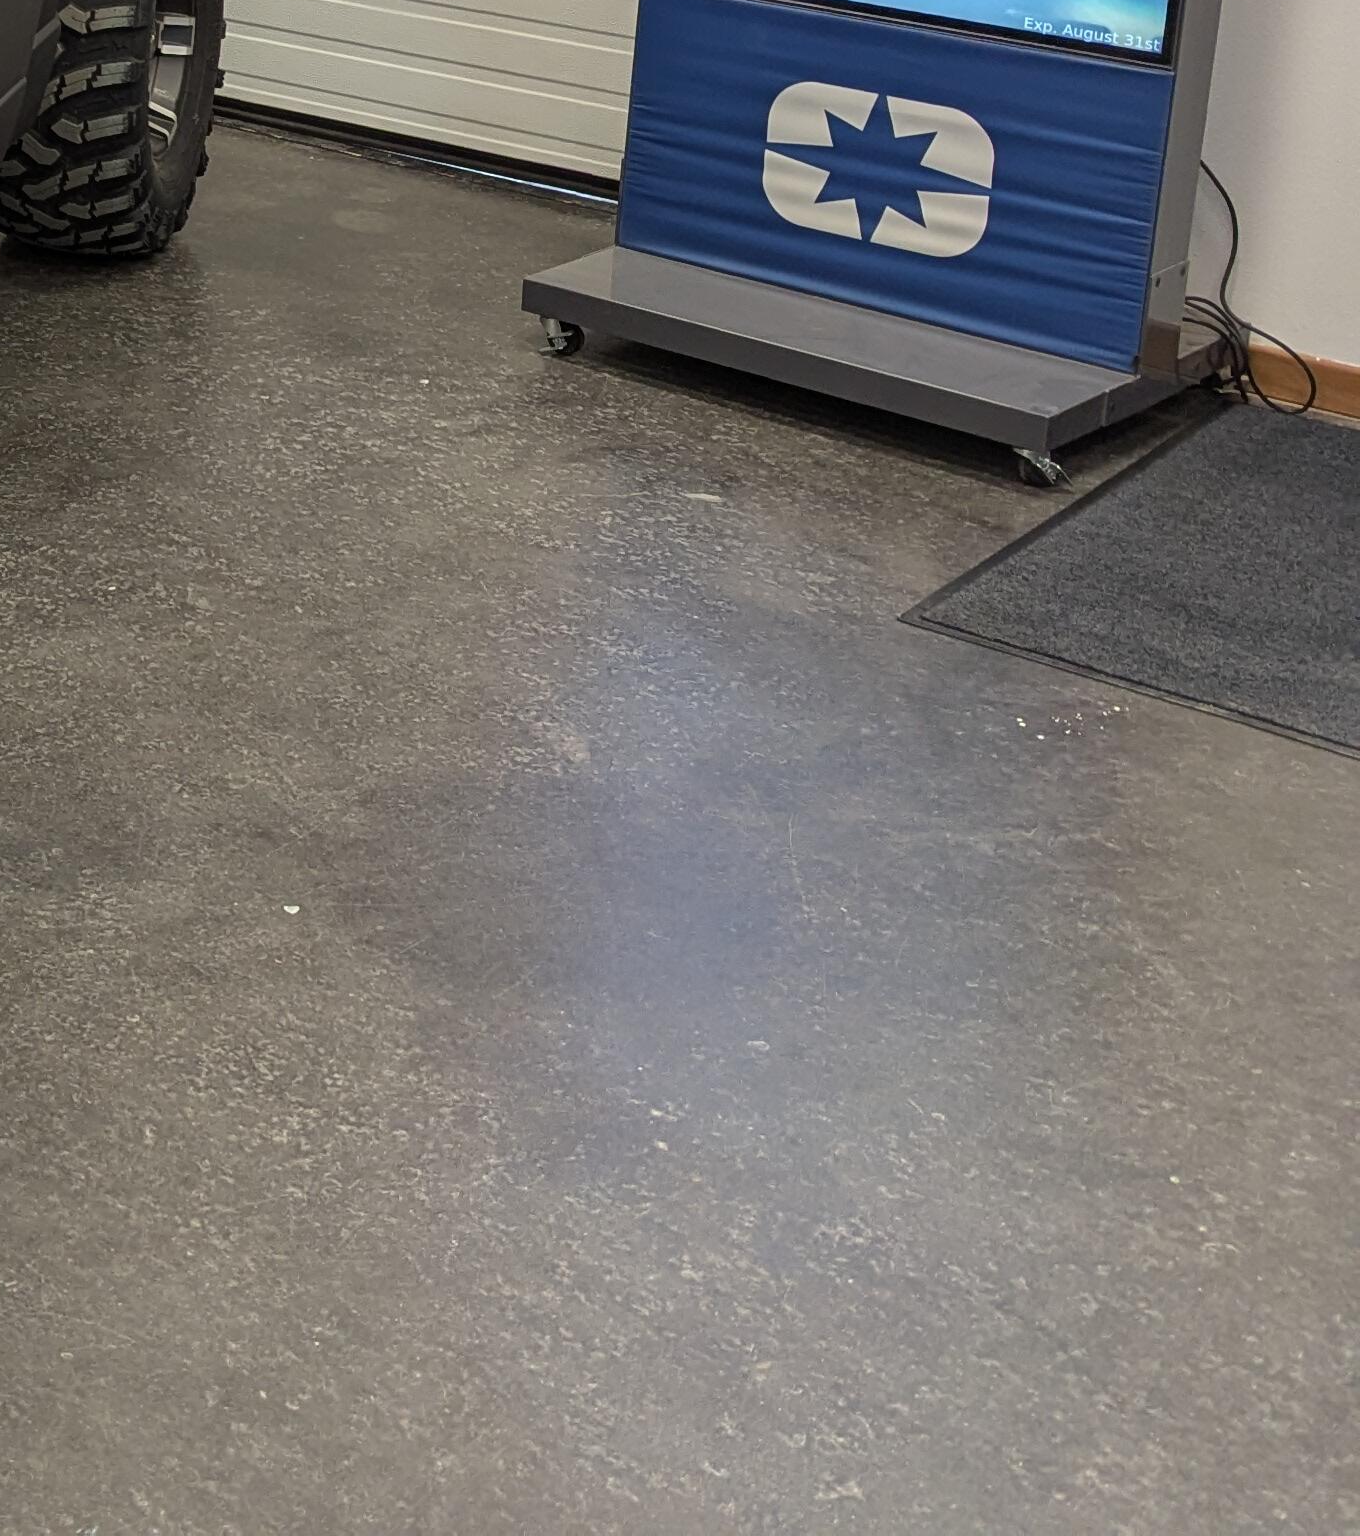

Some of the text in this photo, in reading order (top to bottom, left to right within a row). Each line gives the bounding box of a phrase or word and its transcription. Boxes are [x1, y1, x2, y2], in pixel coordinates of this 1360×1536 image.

[1023, 16, 1161, 52] Exp. August 31st
